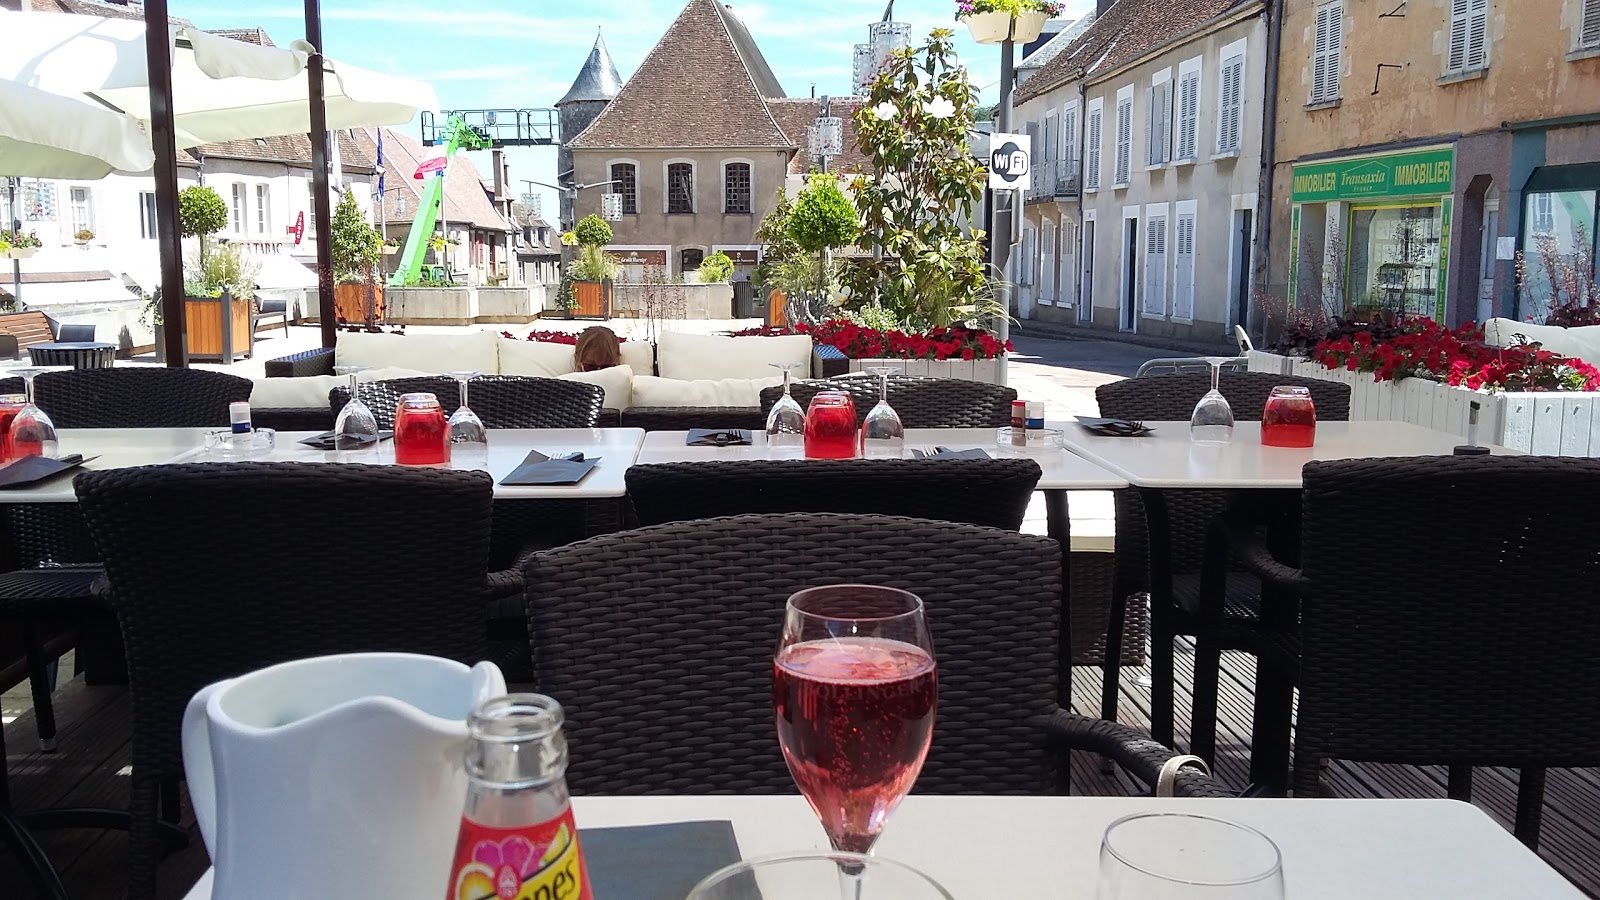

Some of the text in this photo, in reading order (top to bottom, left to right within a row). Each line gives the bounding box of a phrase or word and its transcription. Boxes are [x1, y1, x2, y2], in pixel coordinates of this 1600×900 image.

[994, 153, 1024, 169] WiFi
[1294, 160, 1450, 193] IMMOBILIER Transaxia IMMOBILIER
[252, 242, 283, 255] TABAC
[1437, 213, 1450, 327] IMMOBILIER
